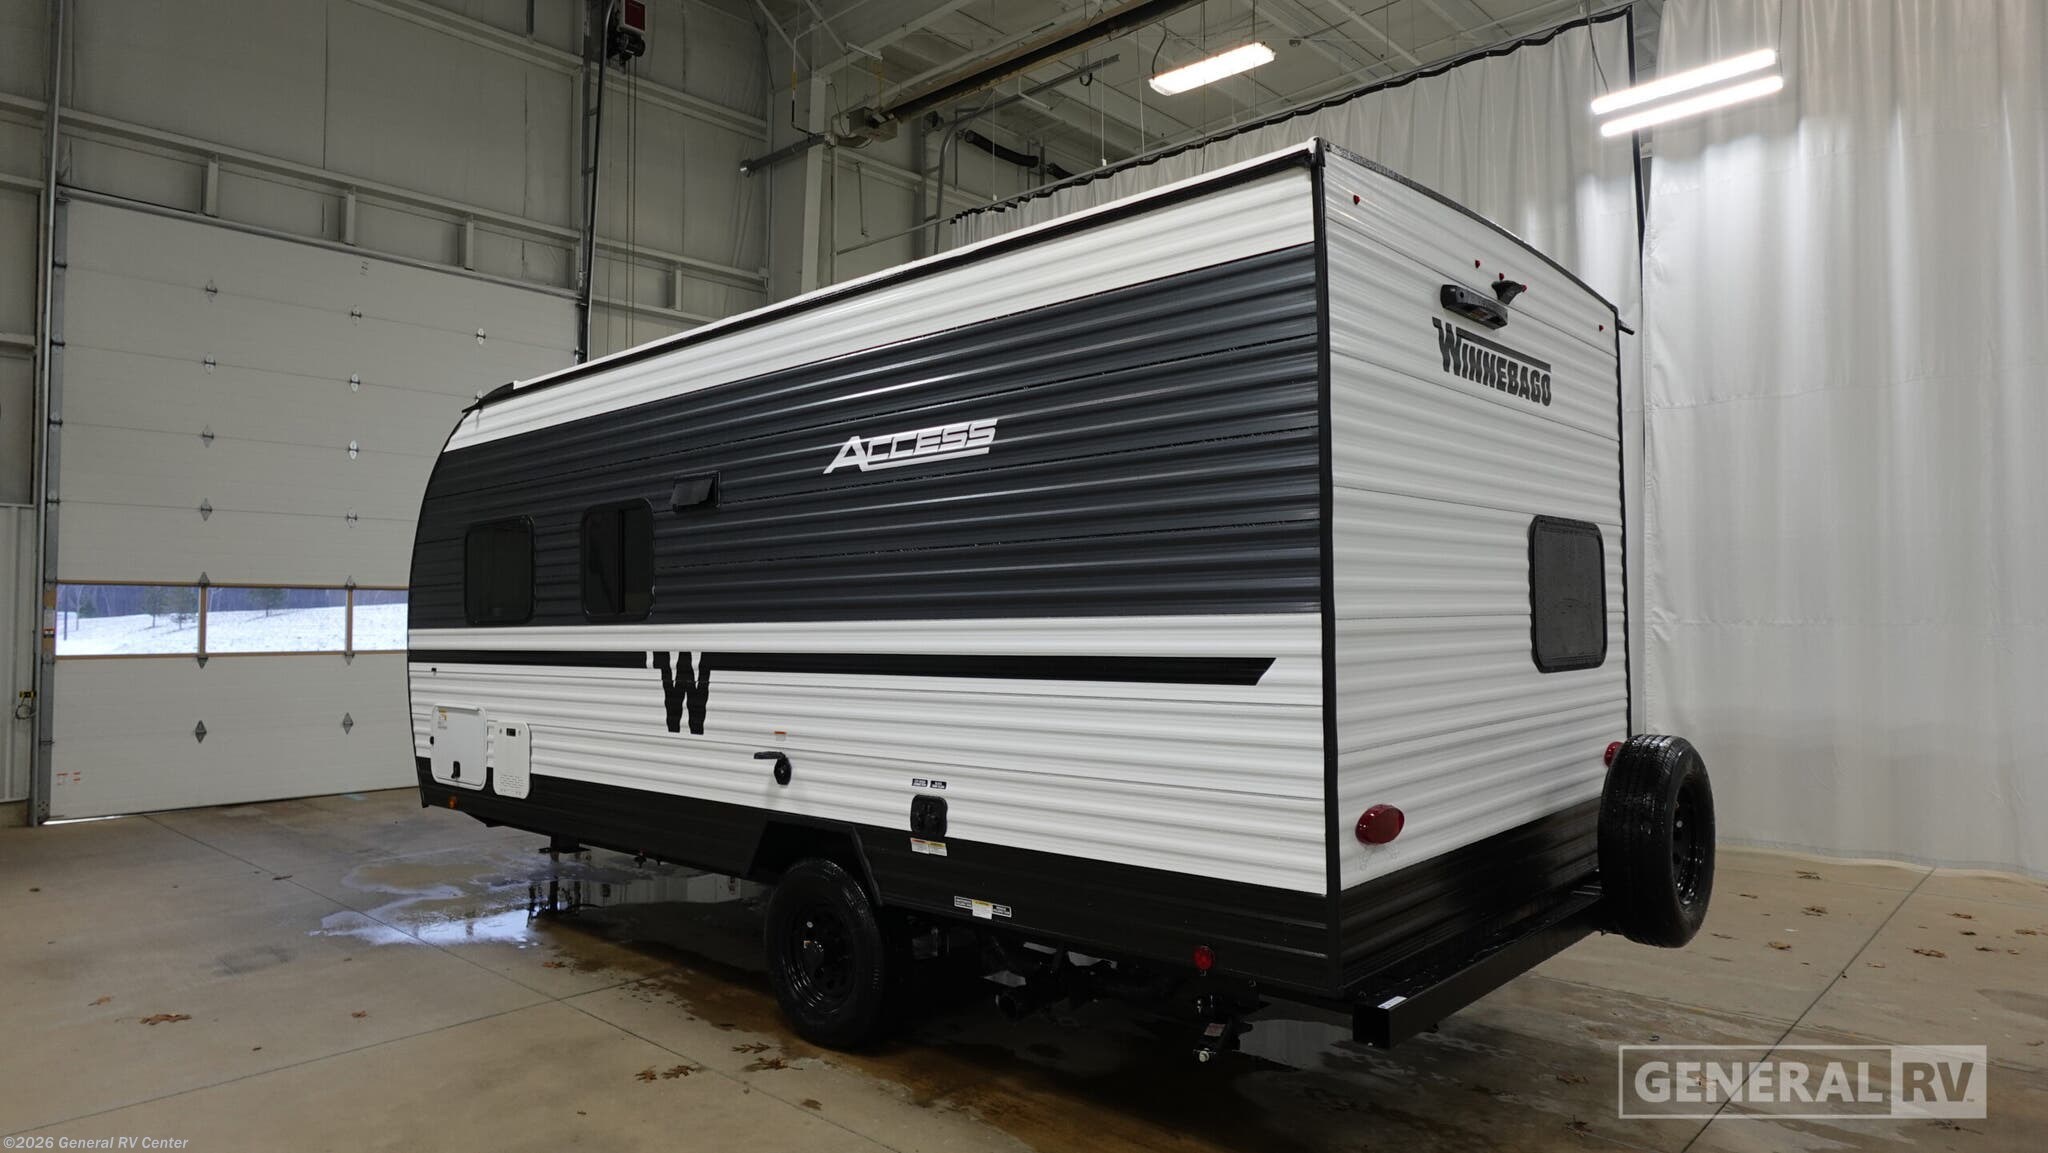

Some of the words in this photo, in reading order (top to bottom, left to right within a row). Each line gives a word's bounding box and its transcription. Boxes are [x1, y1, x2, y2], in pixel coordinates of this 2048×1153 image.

[1432, 316, 1552, 407] WINNEBAGO
[823, 418, 998, 474] ACCESS
[653, 651, 711, 736] W
